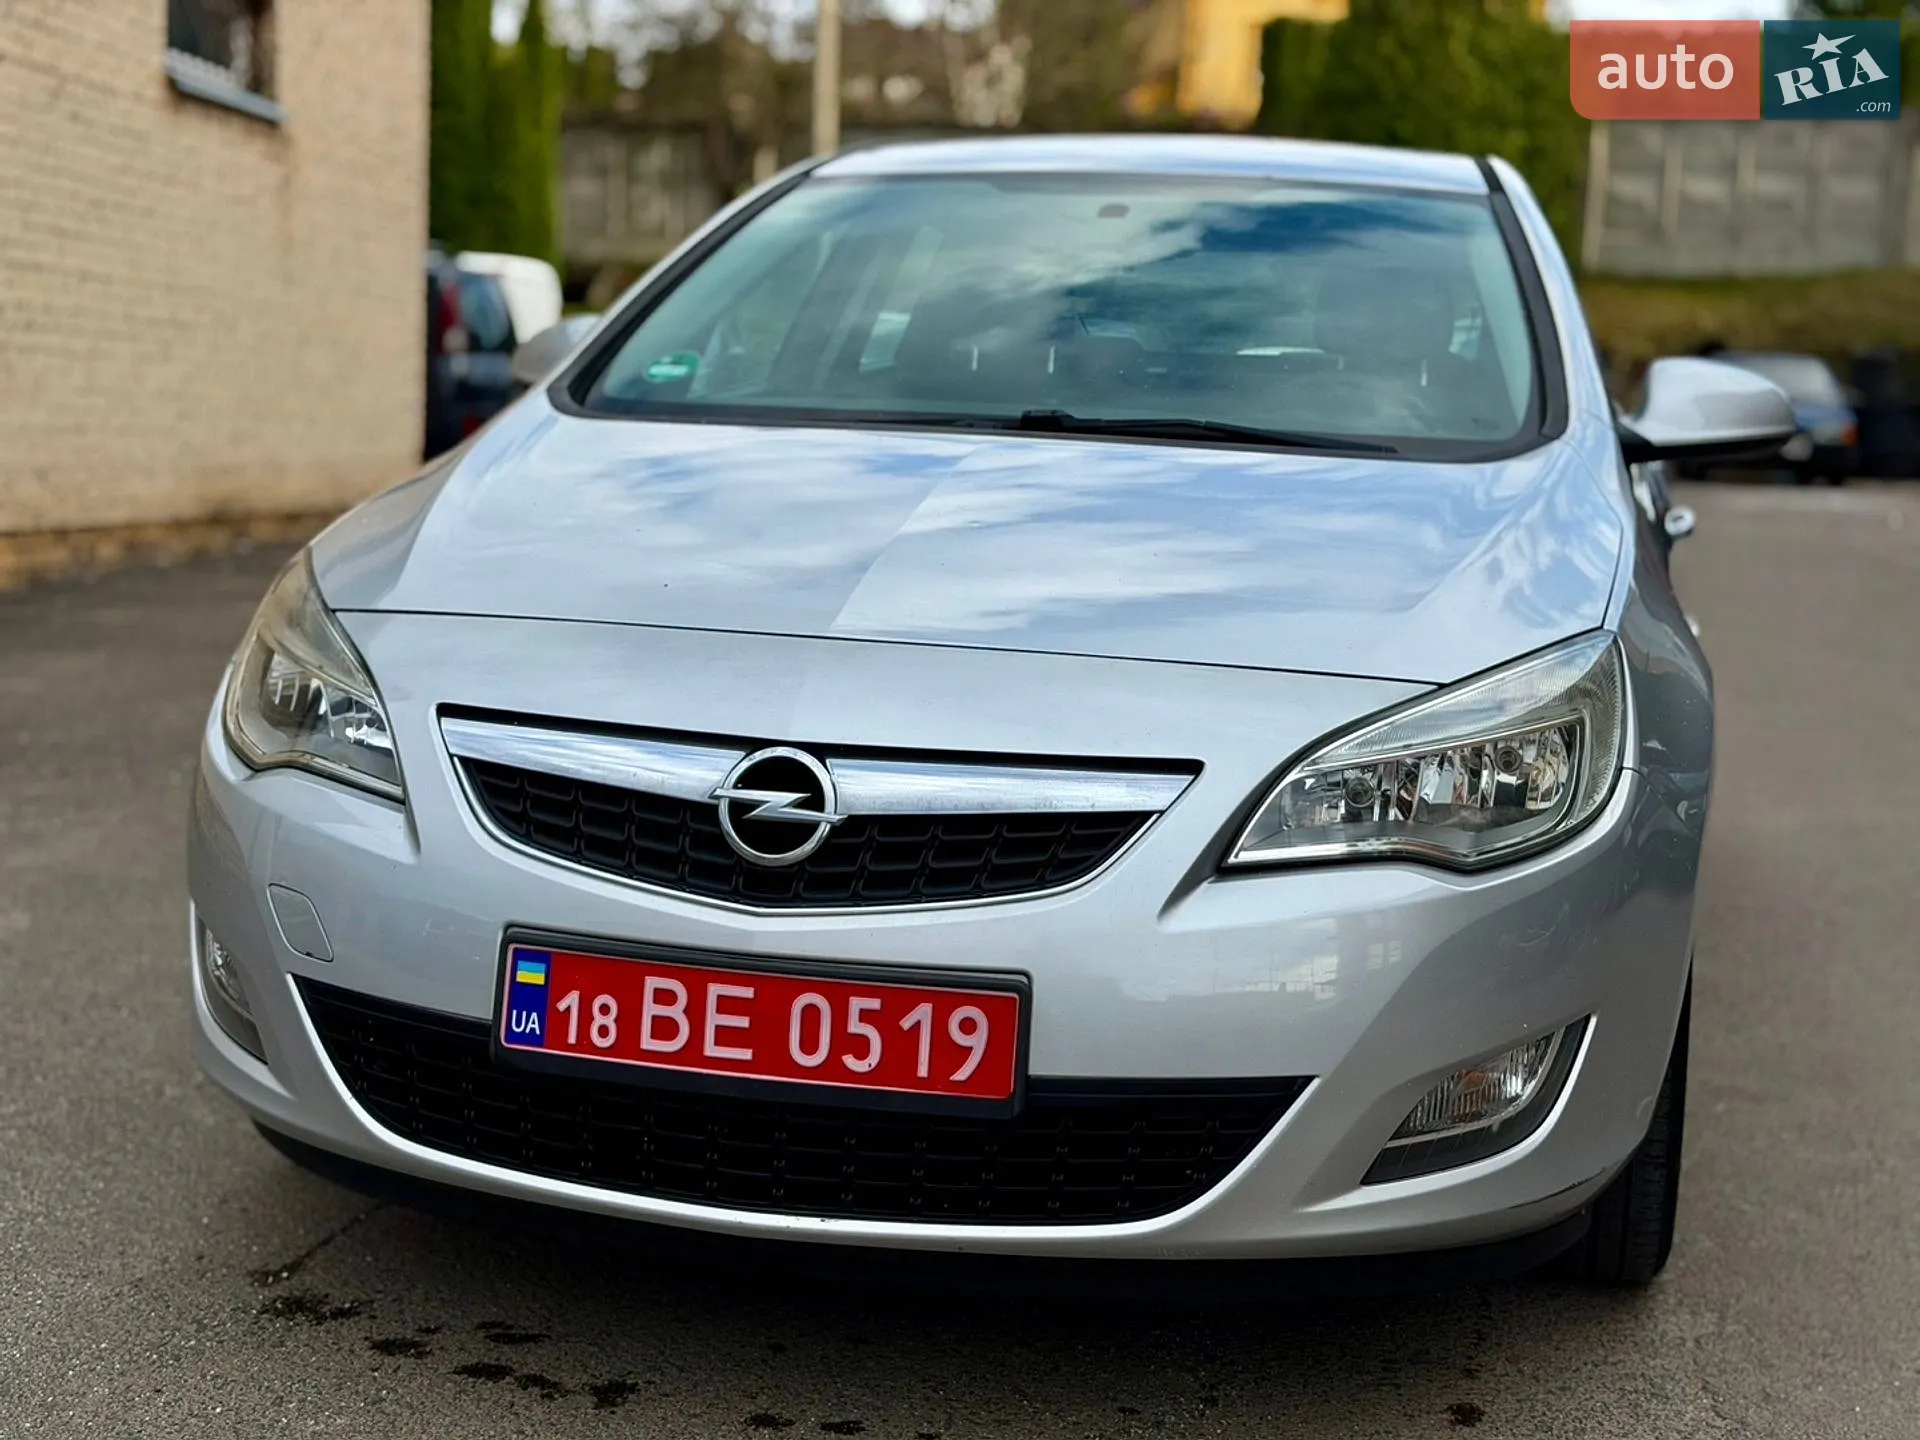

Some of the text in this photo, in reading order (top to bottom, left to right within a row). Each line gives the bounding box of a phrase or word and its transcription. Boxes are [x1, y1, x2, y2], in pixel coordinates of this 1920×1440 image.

[510, 1009, 541, 1036] UA
[555, 975, 989, 1082] 18 BE 0519
